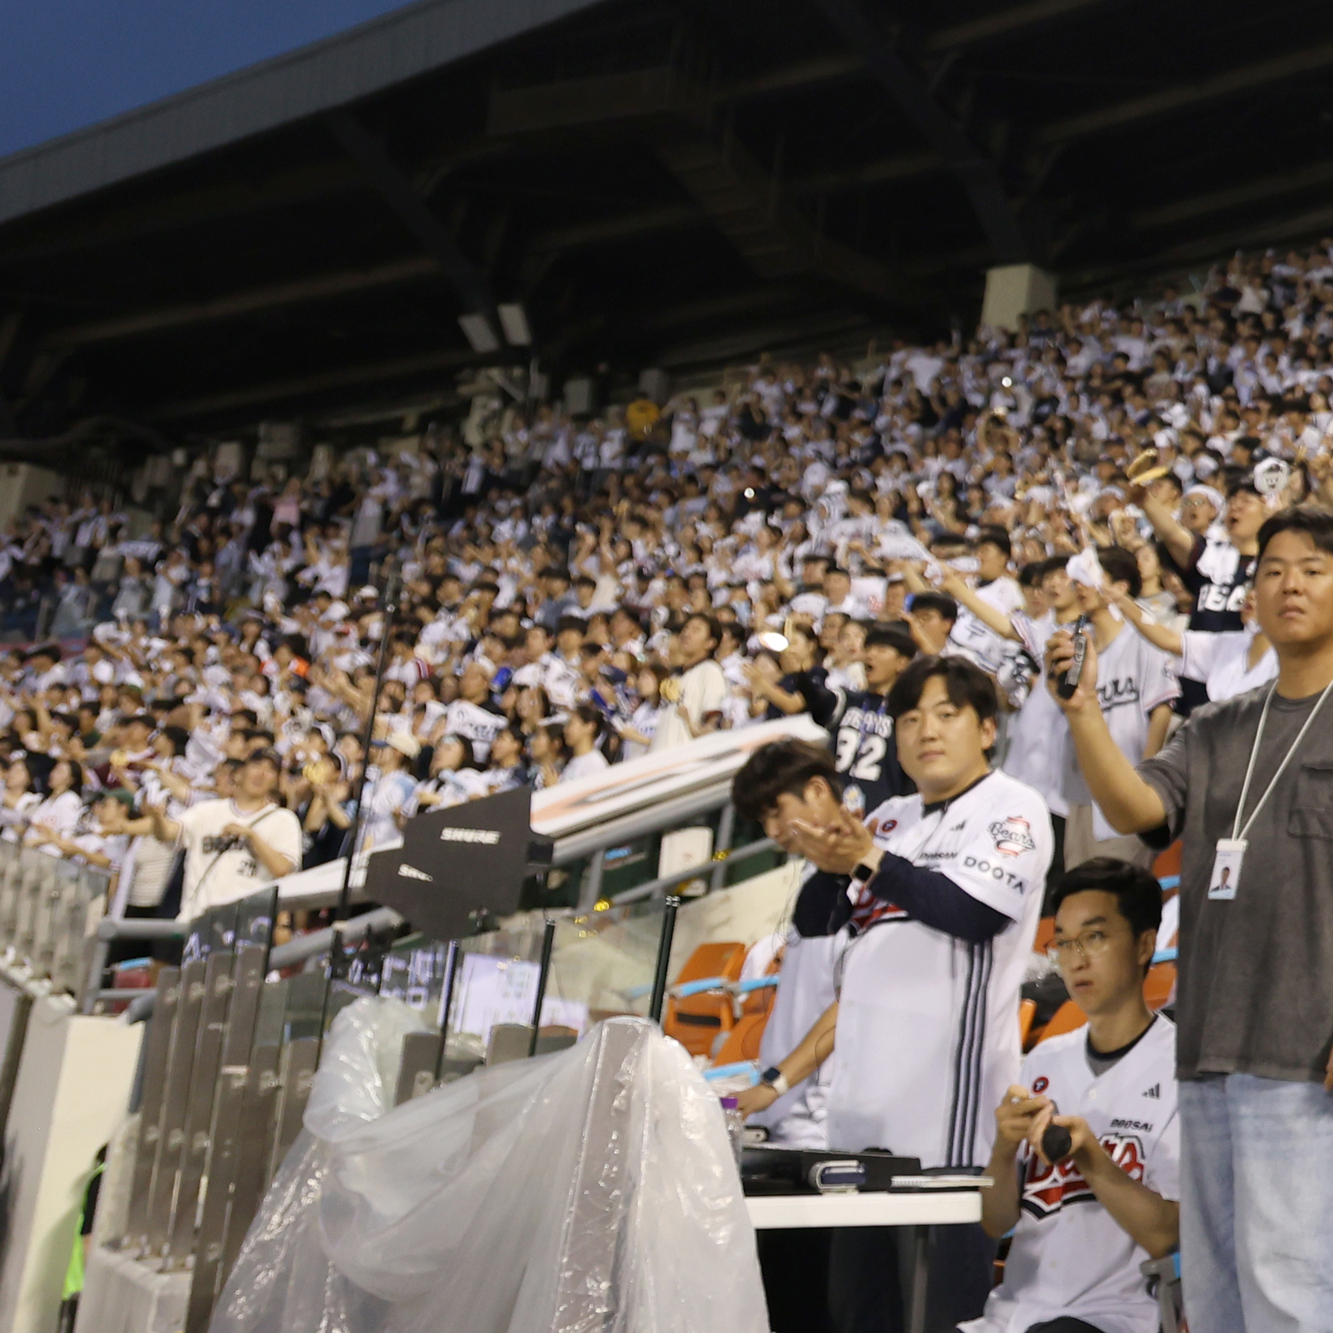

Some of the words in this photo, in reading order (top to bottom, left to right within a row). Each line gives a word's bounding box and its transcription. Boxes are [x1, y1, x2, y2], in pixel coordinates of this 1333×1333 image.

[440, 827, 502, 845] SHURE
[988, 821, 1036, 849] Bears
[964, 856, 1025, 895] DOOTA
